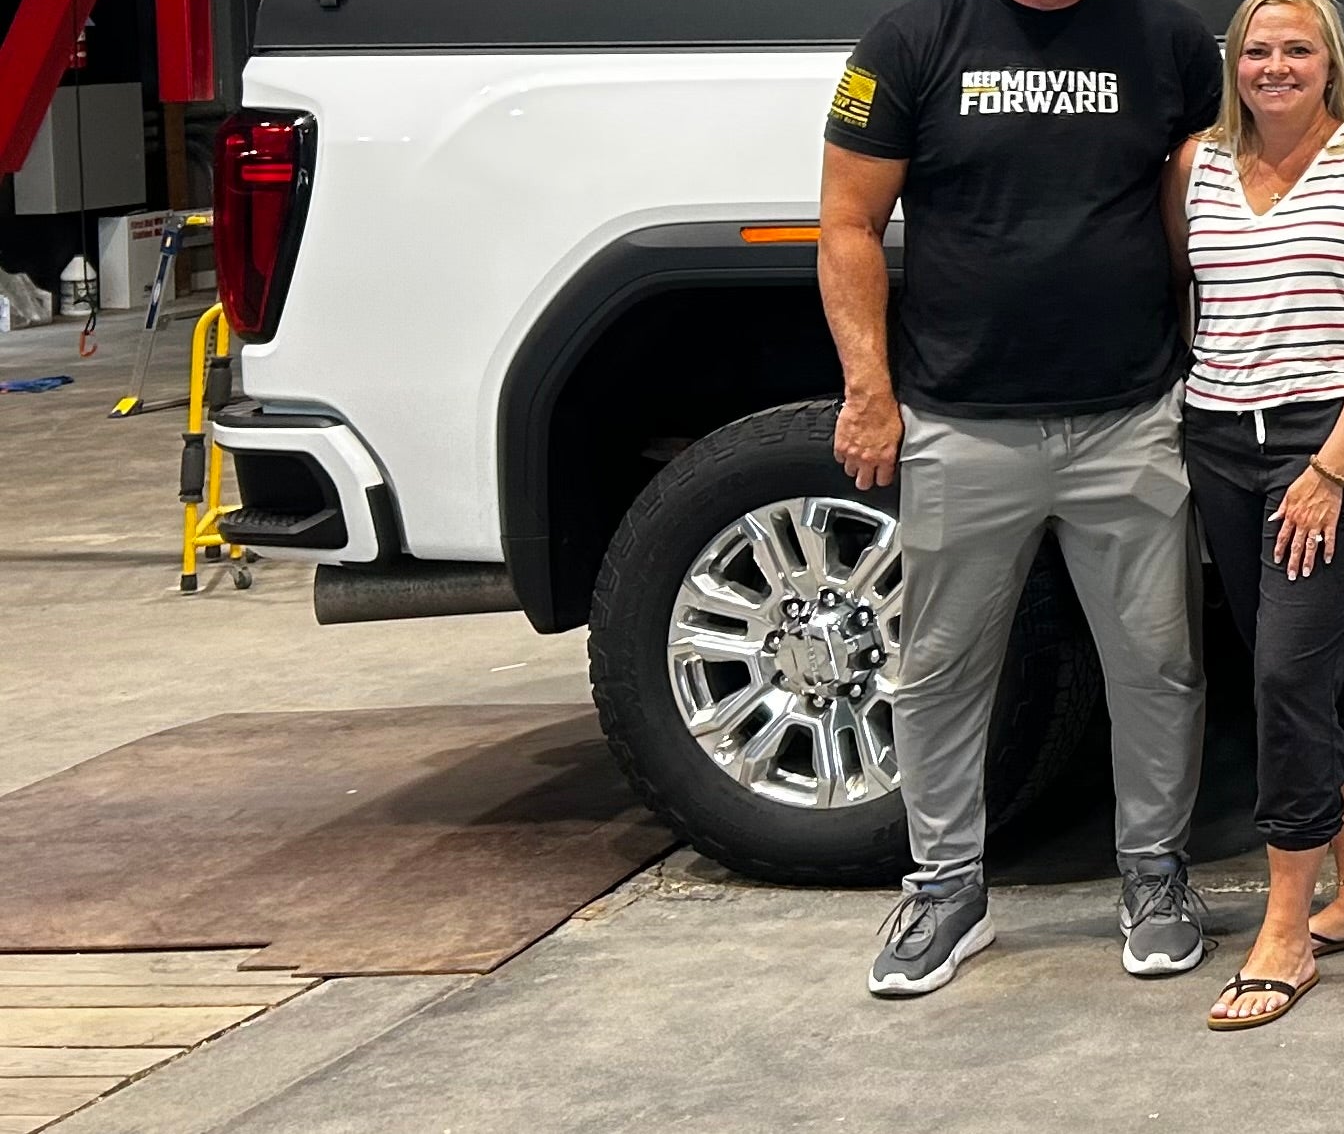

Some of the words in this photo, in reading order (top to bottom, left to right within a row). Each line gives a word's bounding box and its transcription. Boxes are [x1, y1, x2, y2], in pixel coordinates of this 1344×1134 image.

[961, 71, 1001, 88] KEEP
[1001, 70, 1118, 93] MOVING
[960, 91, 1119, 115] FORWARD
